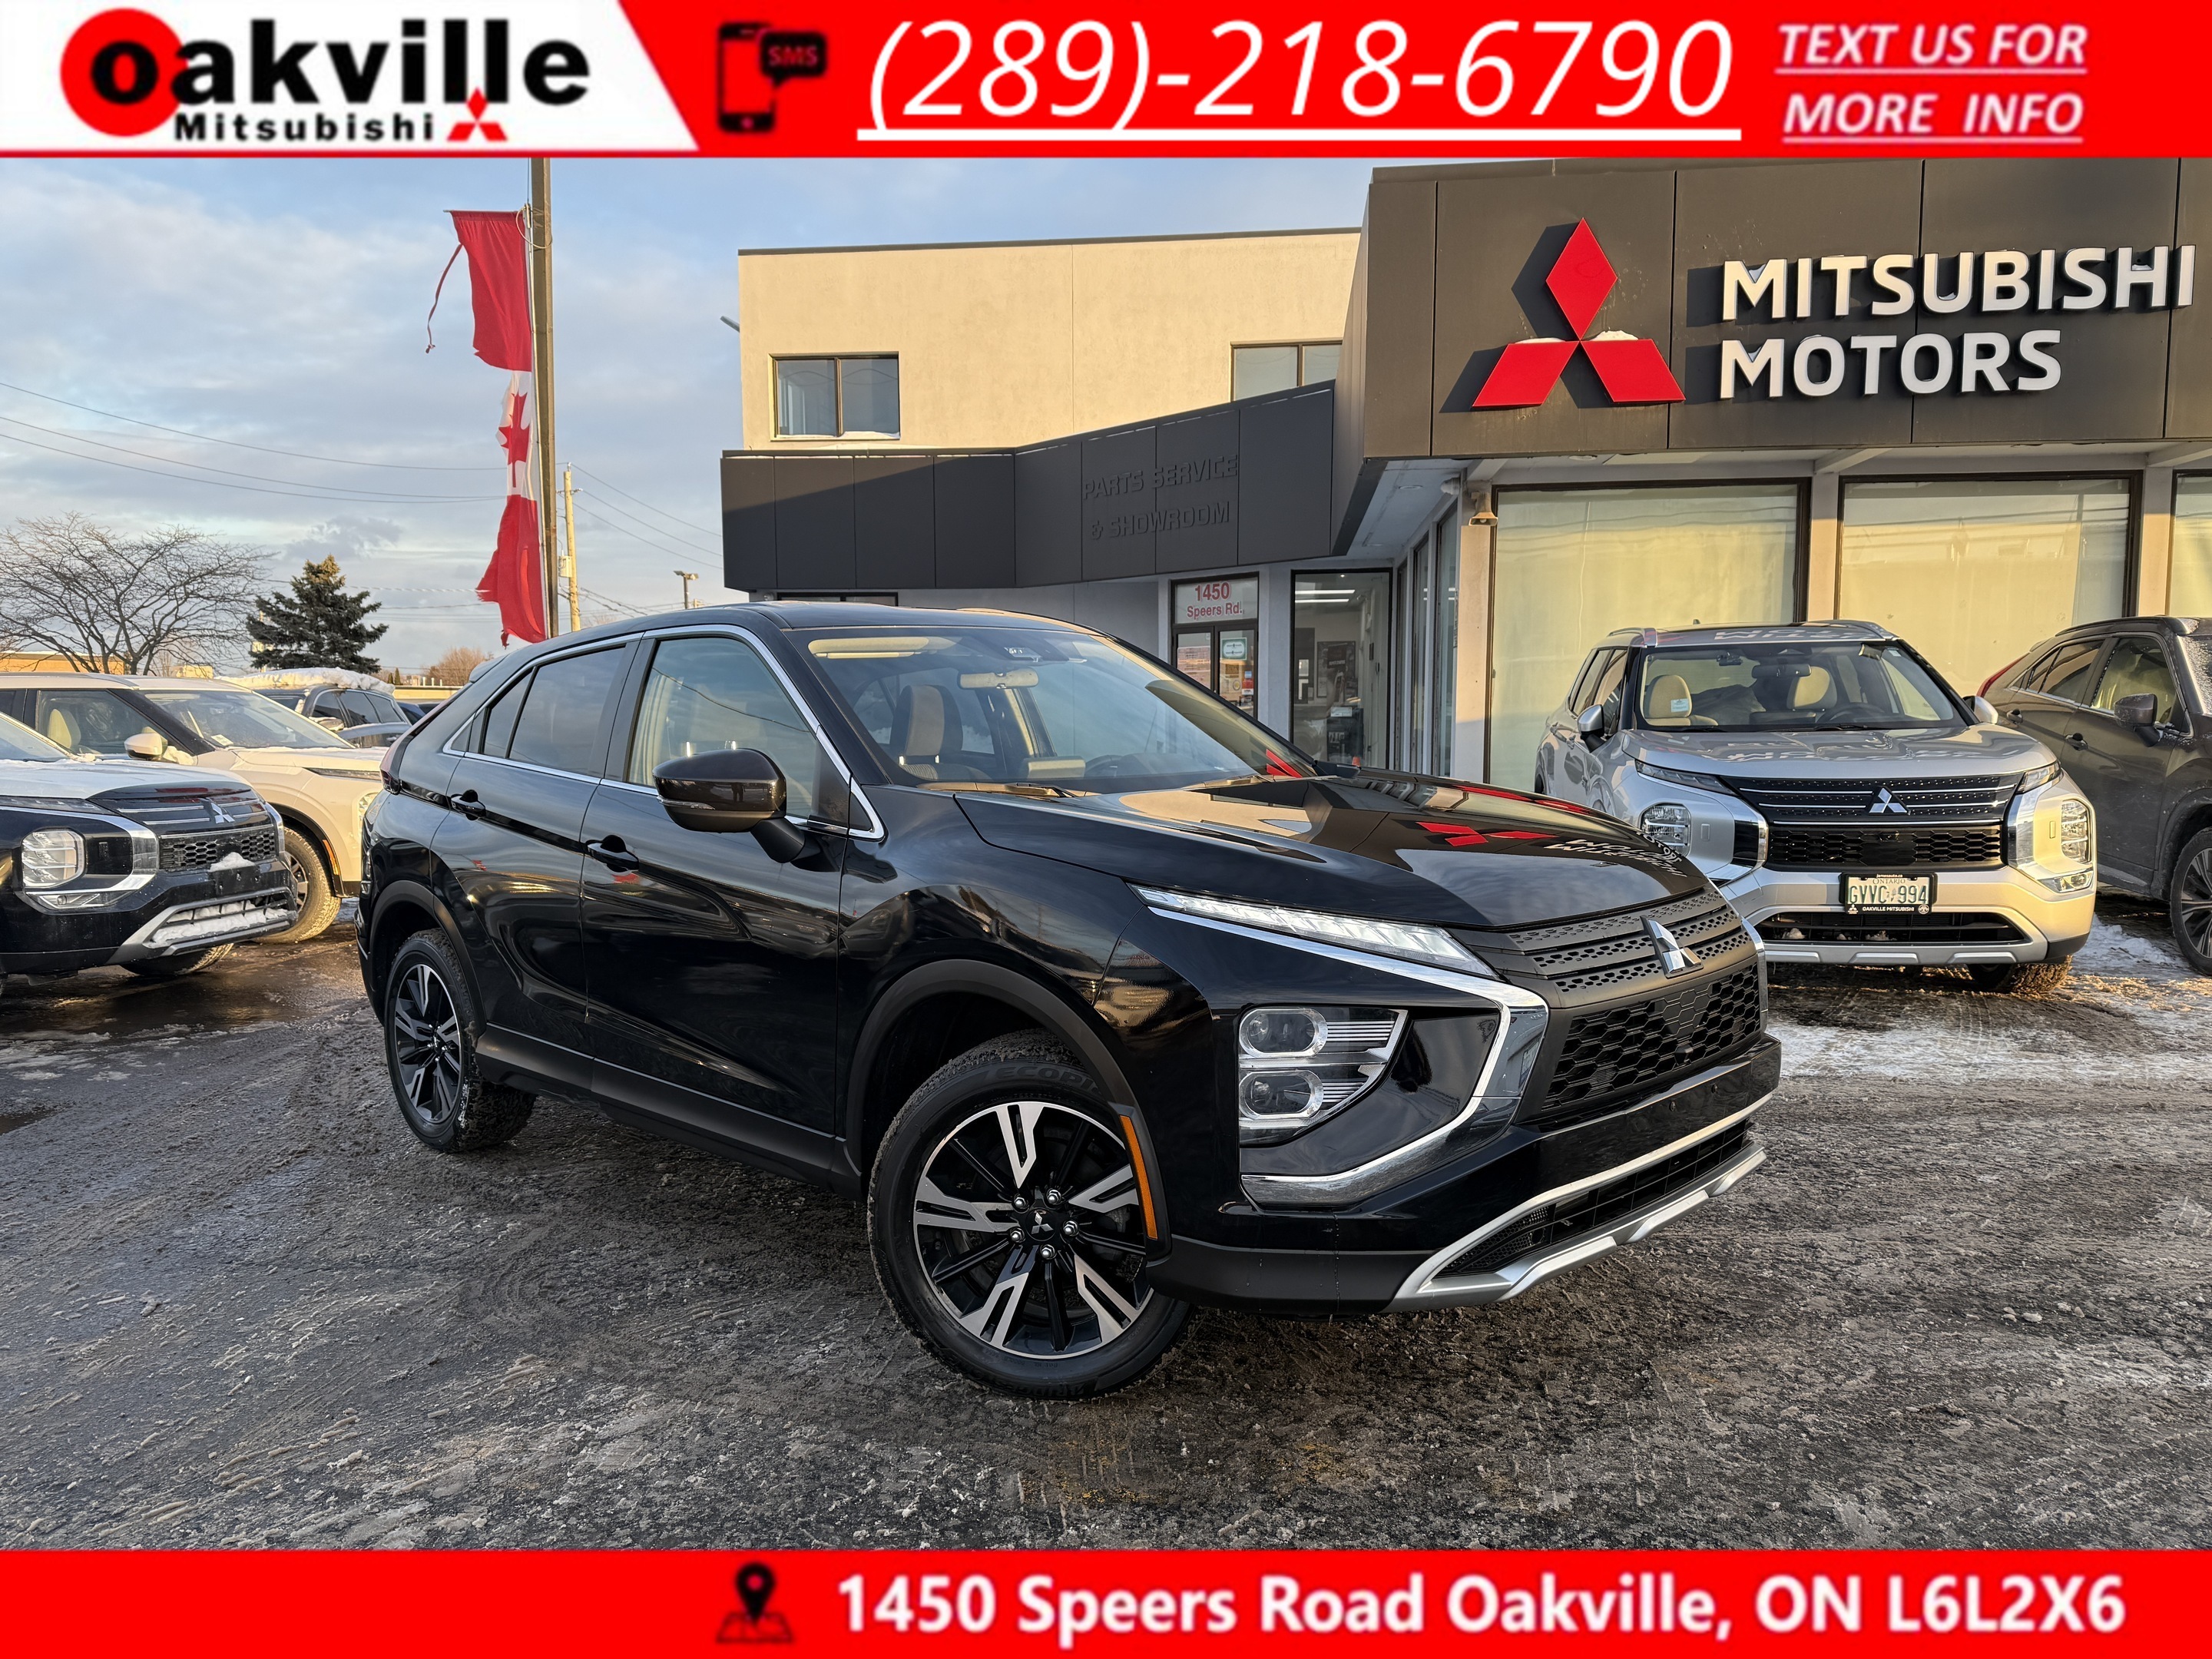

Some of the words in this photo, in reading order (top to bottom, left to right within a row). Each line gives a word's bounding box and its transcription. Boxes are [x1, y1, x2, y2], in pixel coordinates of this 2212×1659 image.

[1722, 244, 2197, 321] MITSUBISHI
[1720, 329, 2062, 399] MOTORS
[1082, 470, 1144, 500] PARTS
[1151, 454, 1238, 489] SERVICE
[1091, 520, 1104, 539] &
[1109, 501, 1230, 538] SHOWROOM
[1187, 604, 1222, 619] Speers
[1224, 601, 1243, 615] Rd.
[1194, 581, 1230, 601] 1450
[1849, 886, 1887, 903] GVVC
[1897, 886, 1927, 903] 994
